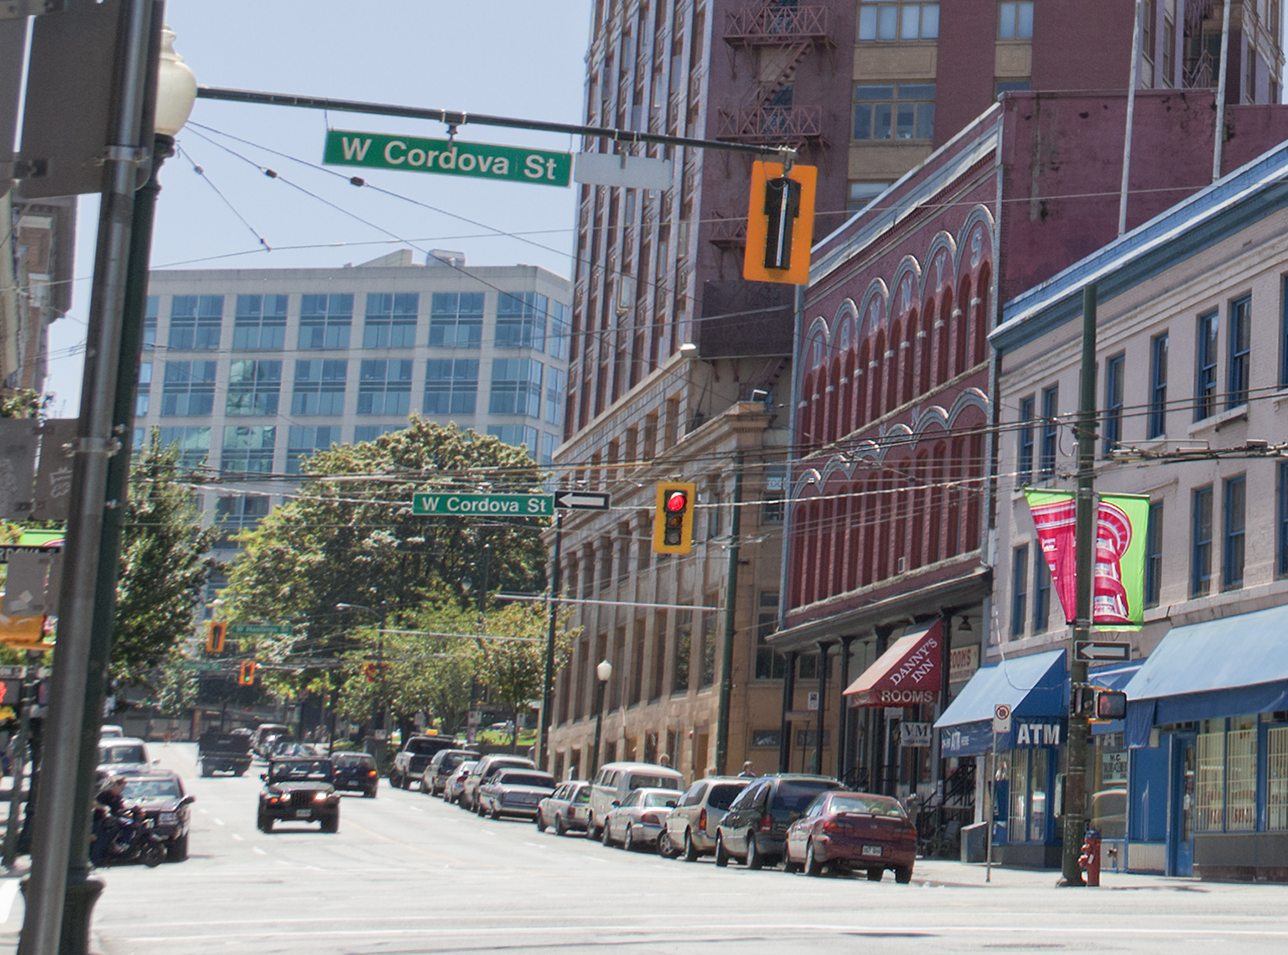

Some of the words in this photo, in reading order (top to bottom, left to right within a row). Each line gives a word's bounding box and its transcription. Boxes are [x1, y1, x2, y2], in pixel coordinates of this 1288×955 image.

[342, 136, 373, 161] W
[384, 140, 510, 175] Cordova
[523, 154, 557, 180] St
[422, 497, 440, 511] W
[446, 497, 519, 512] Cordova
[527, 498, 547, 513] St
[889, 637, 938, 686] DANNY'S
[911, 659, 935, 683] INN
[881, 690, 933, 703] ROOMS
[904, 724, 928, 737] VM
[1017, 724, 1060, 745] ATM
